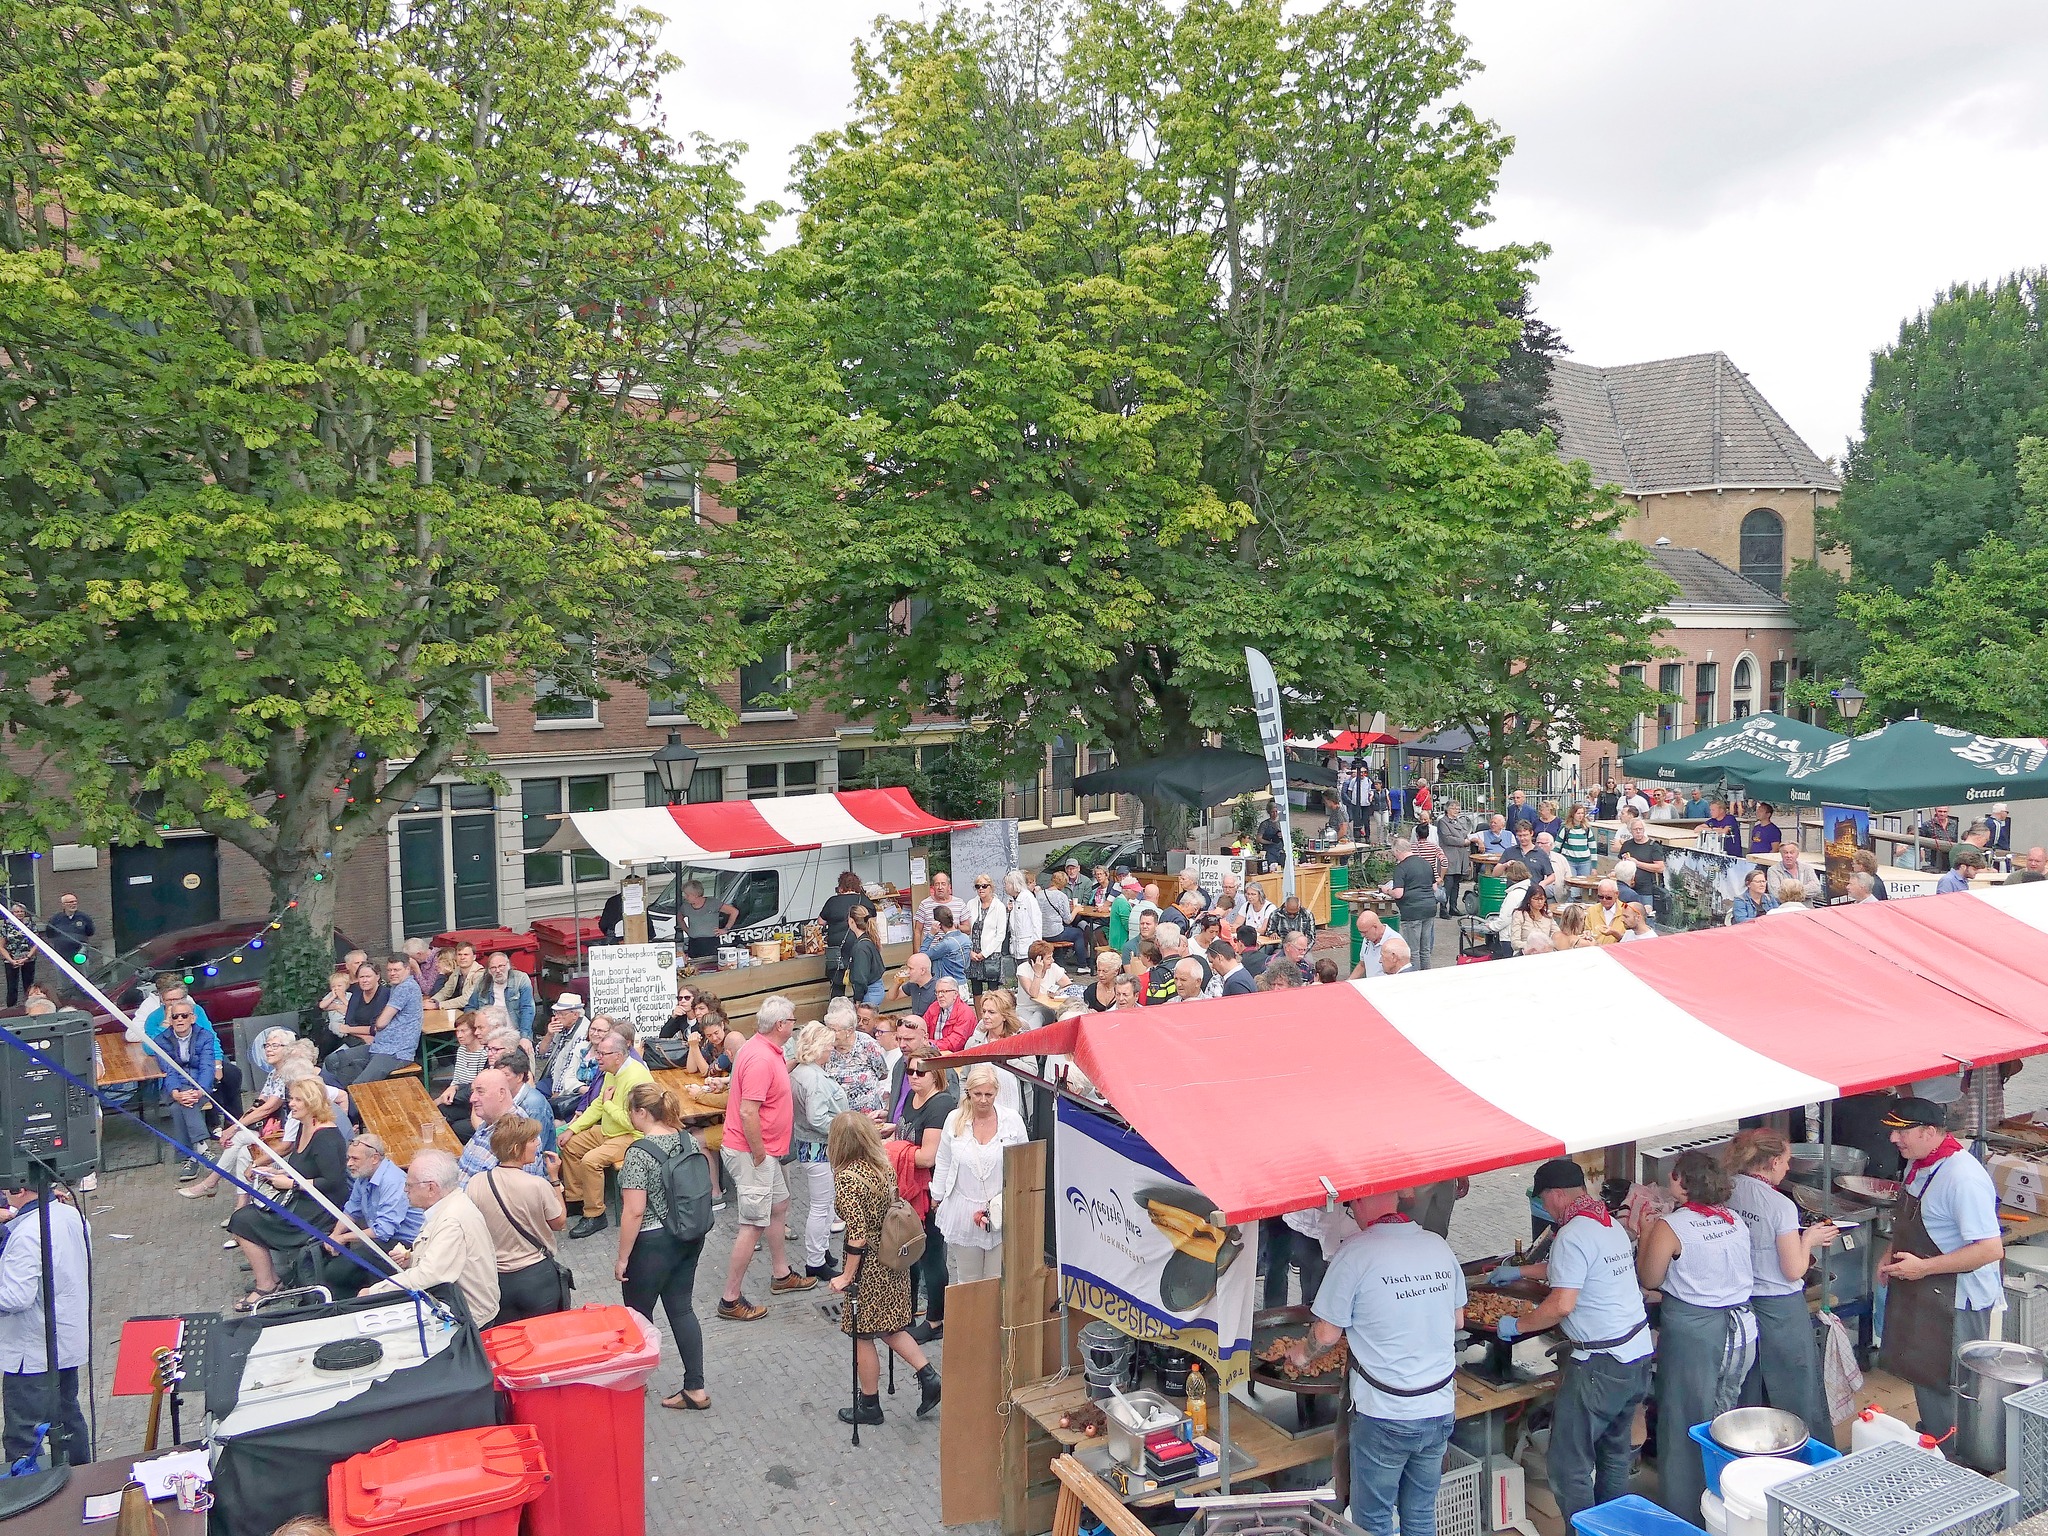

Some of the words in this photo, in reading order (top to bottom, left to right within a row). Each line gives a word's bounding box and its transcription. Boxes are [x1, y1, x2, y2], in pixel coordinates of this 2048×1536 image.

[1657, 766, 1676, 778] Brand
[1790, 788, 1811, 801] Brand
[1965, 786, 2006, 801] Brand
[1191, 857, 1219, 867] Koffie
[1200, 871, 1219, 880] 1782
[1890, 882, 1920, 893] Bier
[591, 968, 605, 977] Aan
[609, 965, 629, 976] boord
[591, 975, 641, 986] Houdbaarheid
[592, 985, 619, 996] Voedsel
[624, 981, 666, 995] belangrijk
[593, 995, 627, 1006] Proviand
[630, 994, 649, 1003] werd
[651, 993, 676, 1002] daarom
[593, 1003, 629, 1015] gepekeld
[633, 1001, 674, 1014] (gezouten)
[636, 1012, 668, 1026] gerookt
[634, 1022, 664, 1033] Voorbe
[1741, 1210, 1760, 1222] ROG
[1689, 1219, 1711, 1228] Visch
[1702, 1231, 1724, 1242] lekker
[1603, 1253, 1621, 1264] Visch
[1381, 1273, 1412, 1285] Visch
[1414, 1273, 1432, 1282] van
[1395, 1288, 1427, 1300] lekker
